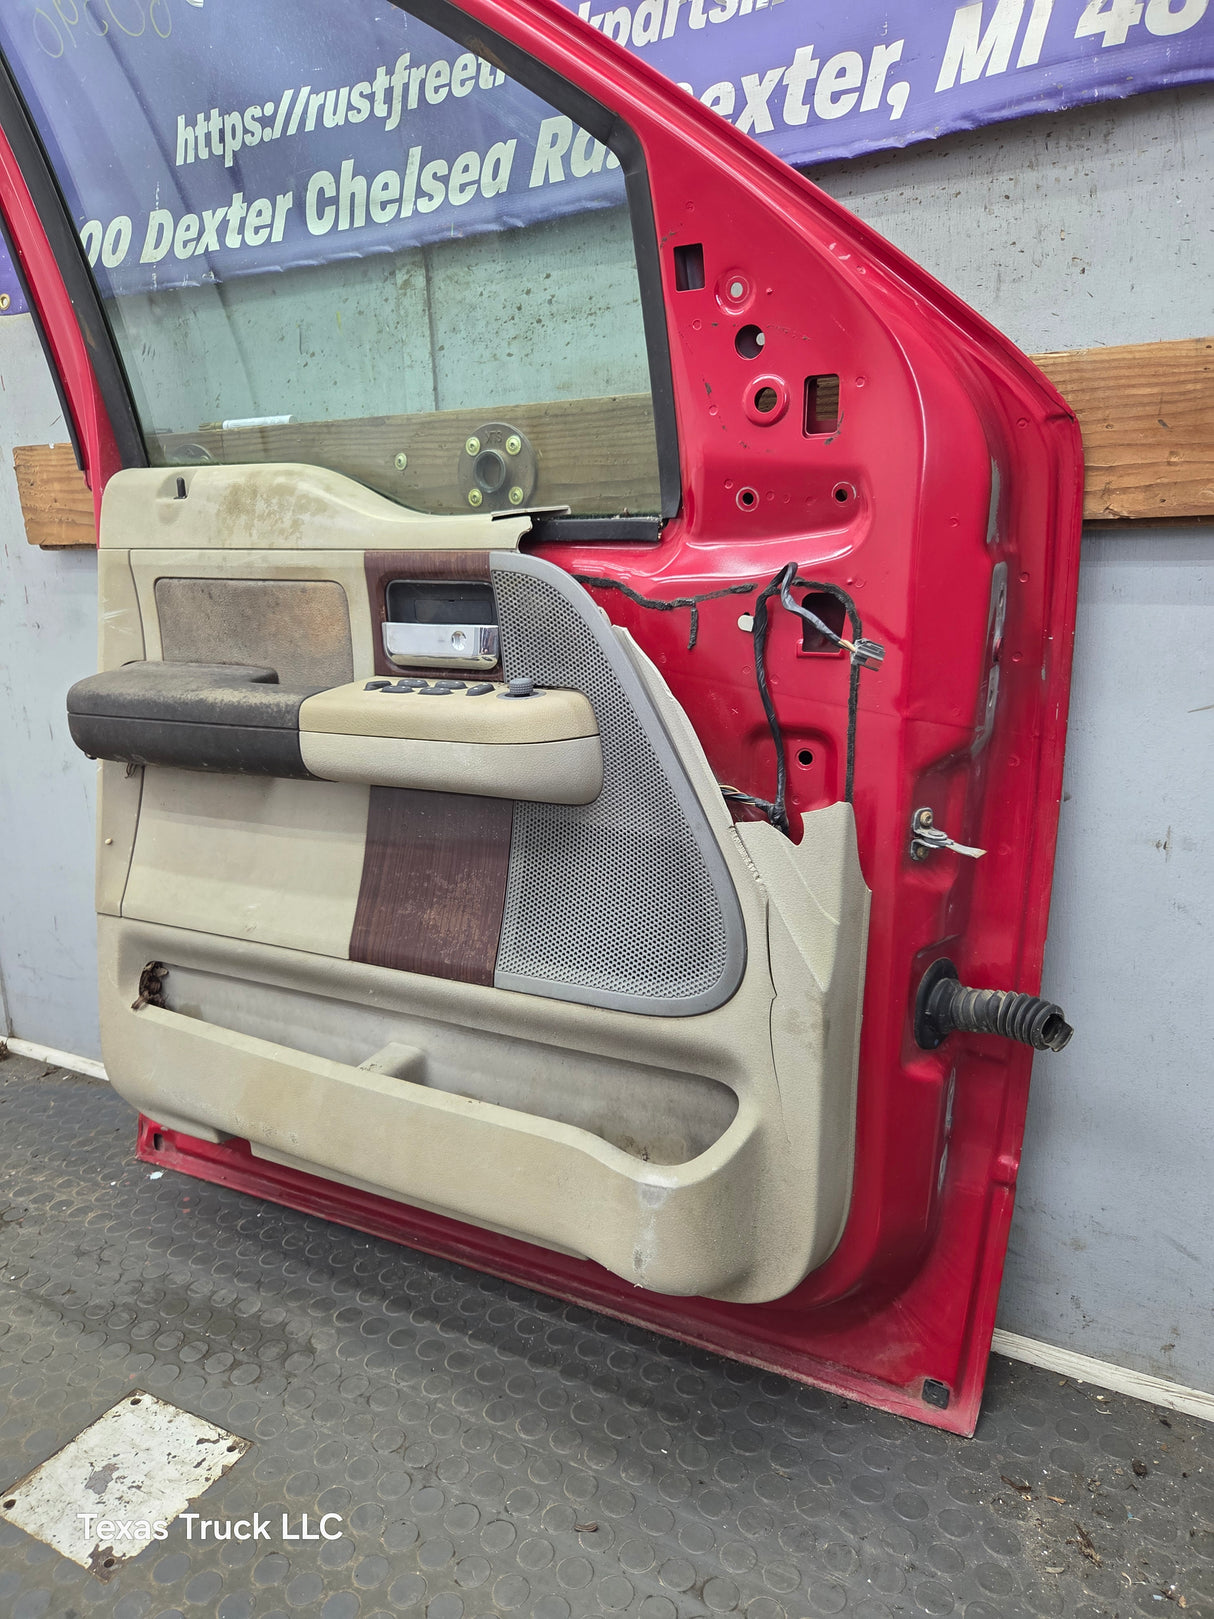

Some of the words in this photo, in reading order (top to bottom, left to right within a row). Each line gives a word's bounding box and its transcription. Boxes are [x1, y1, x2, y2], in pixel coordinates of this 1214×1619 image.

[139, 192, 293, 264] Dexter
[305, 138, 517, 236] Chelsea
[674, 39, 910, 135] exter,
[934, 0, 1054, 93] MI
